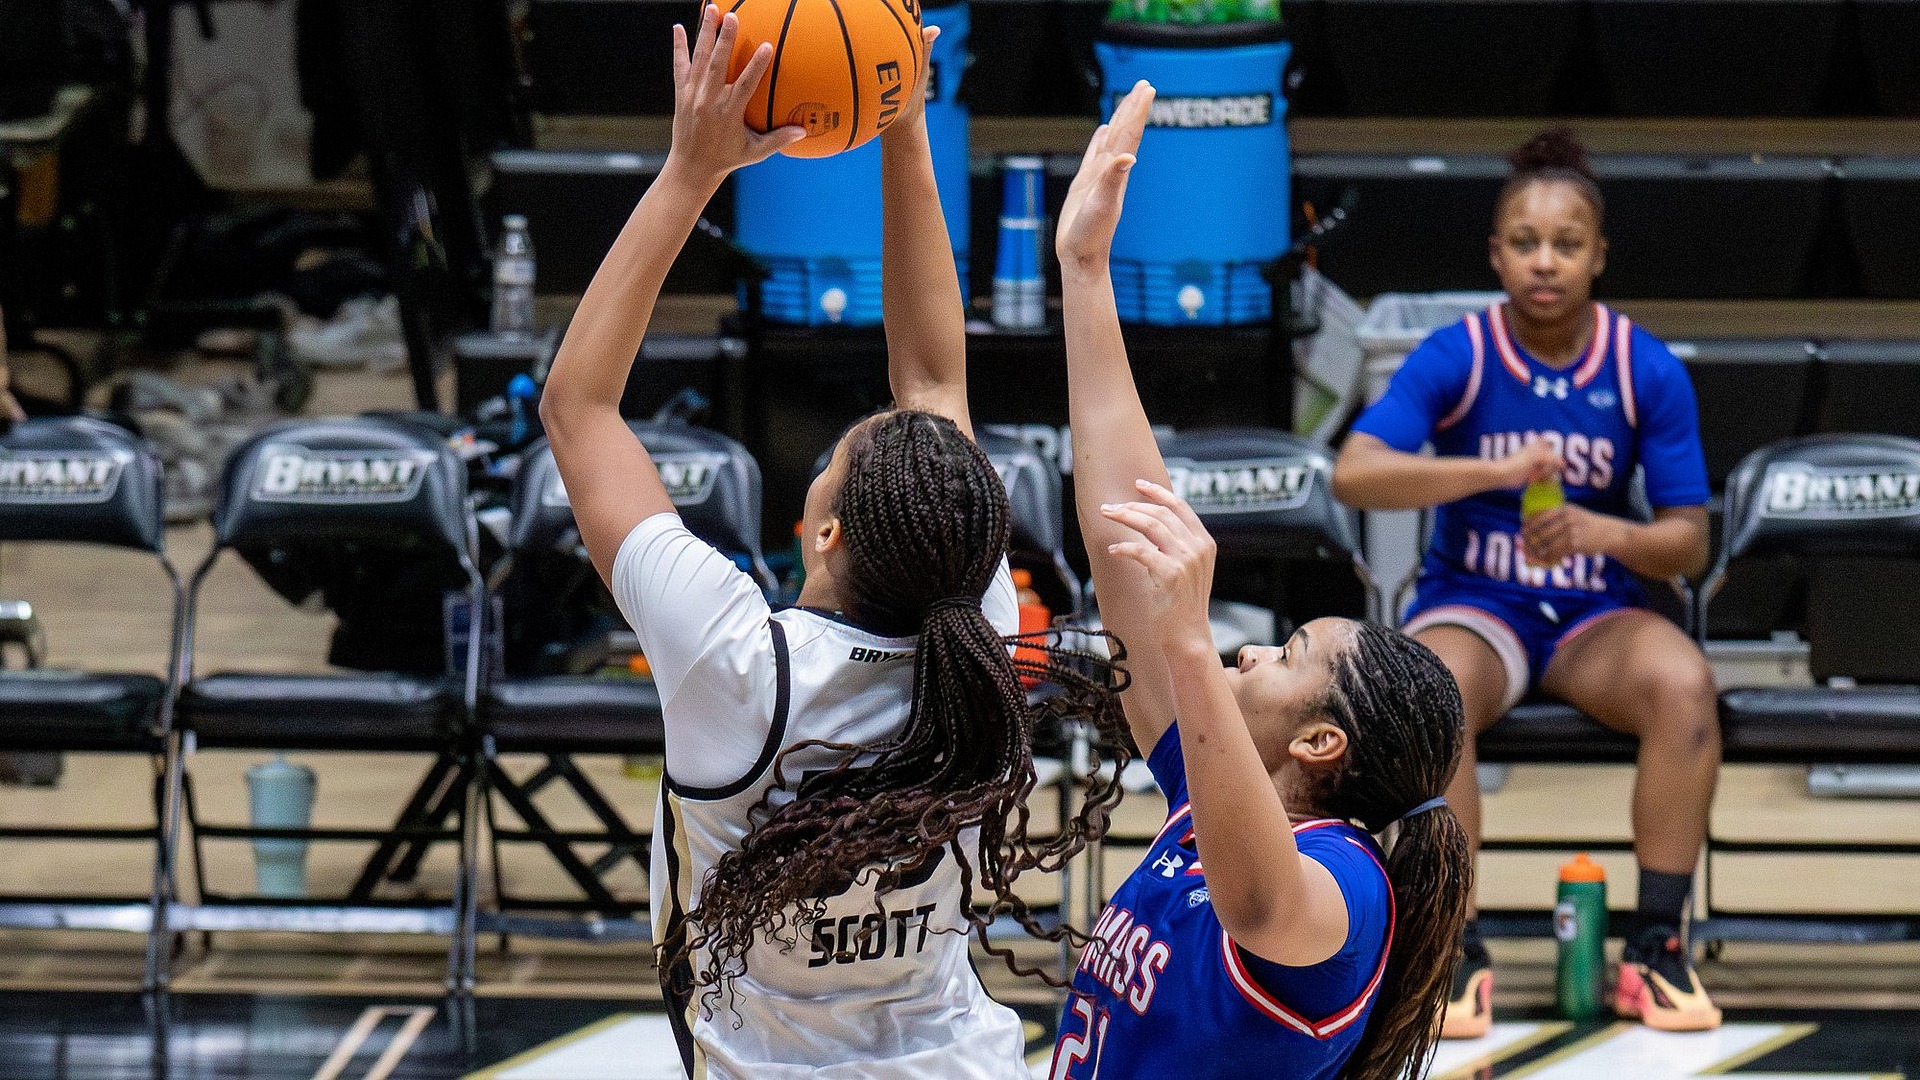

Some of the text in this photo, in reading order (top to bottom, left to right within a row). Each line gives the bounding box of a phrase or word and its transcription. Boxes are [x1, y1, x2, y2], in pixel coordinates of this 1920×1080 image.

[1116, 95, 1269, 127] WERADE
[0, 459, 119, 485] RYANT
[263, 454, 418, 493] BRYANT
[849, 646, 916, 663] BRY
[808, 903, 937, 968] SCOTT
[1080, 904, 1172, 1015] MASS
